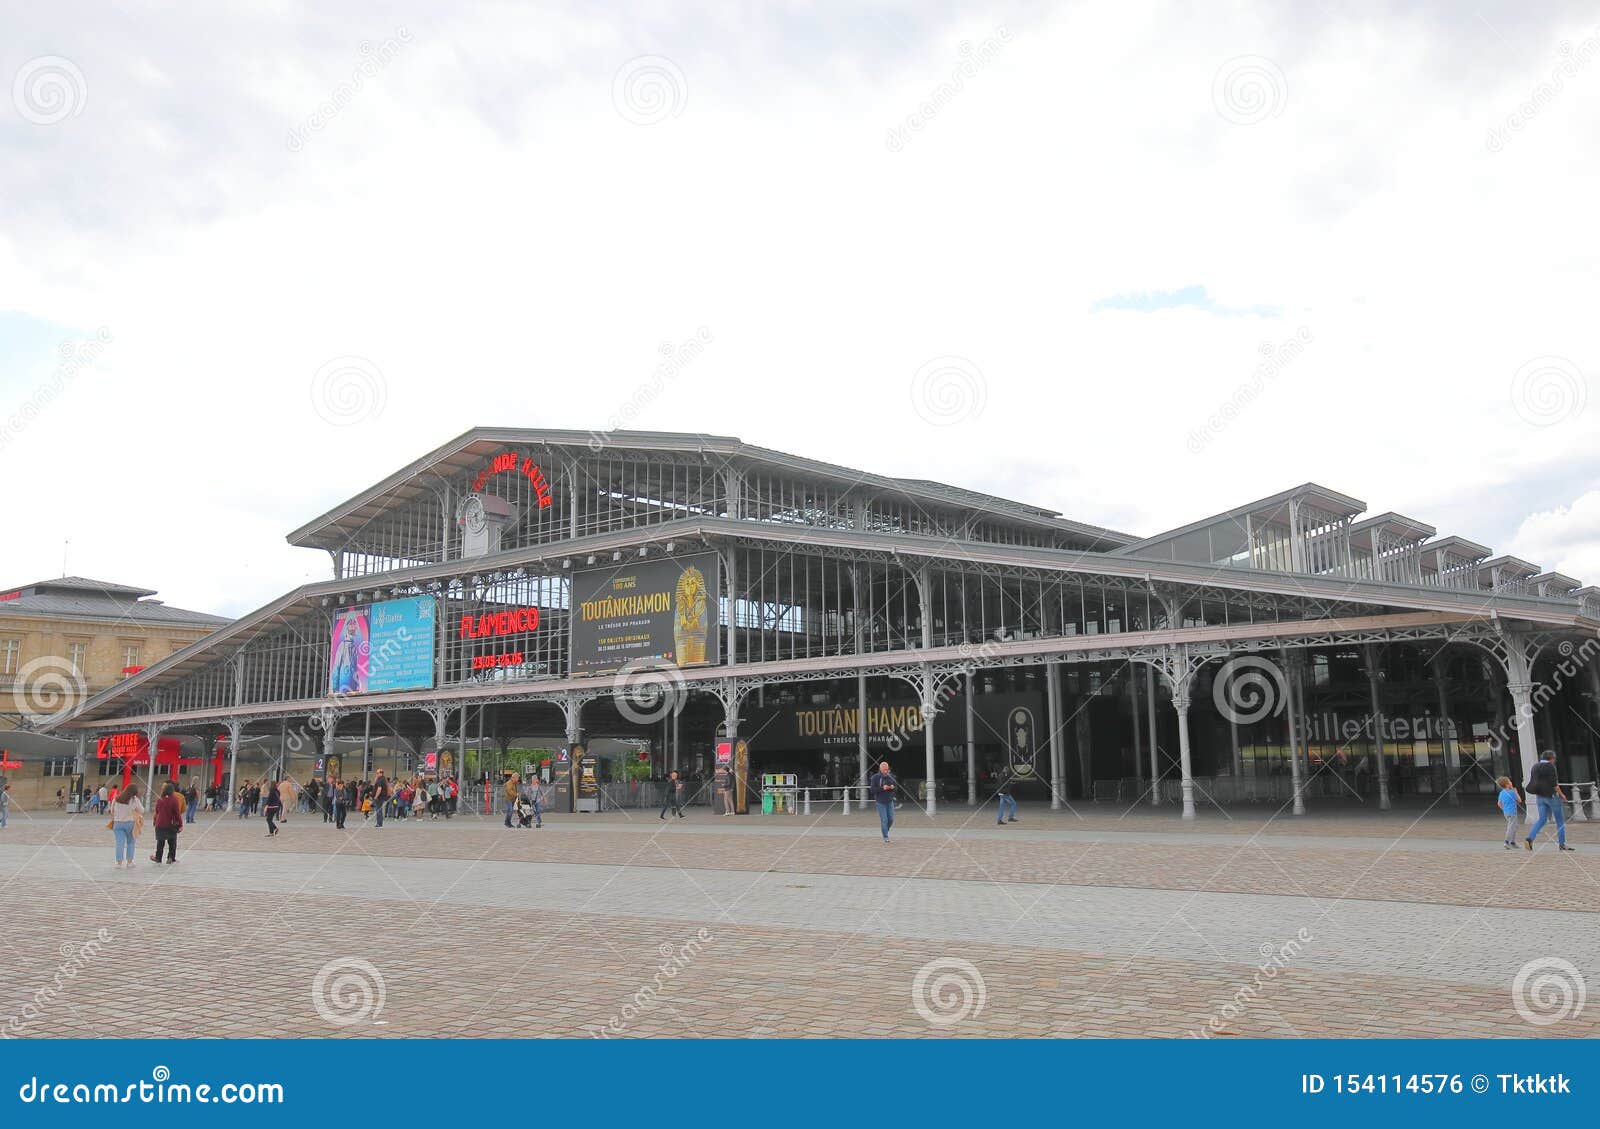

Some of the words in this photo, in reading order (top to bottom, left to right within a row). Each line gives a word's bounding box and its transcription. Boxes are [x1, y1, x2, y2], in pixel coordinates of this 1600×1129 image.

[580, 592, 671, 621] TOUTÂNKHAMON
[461, 607, 538, 638] FLAMENCO
[1295, 709, 1457, 740] Billetterie
